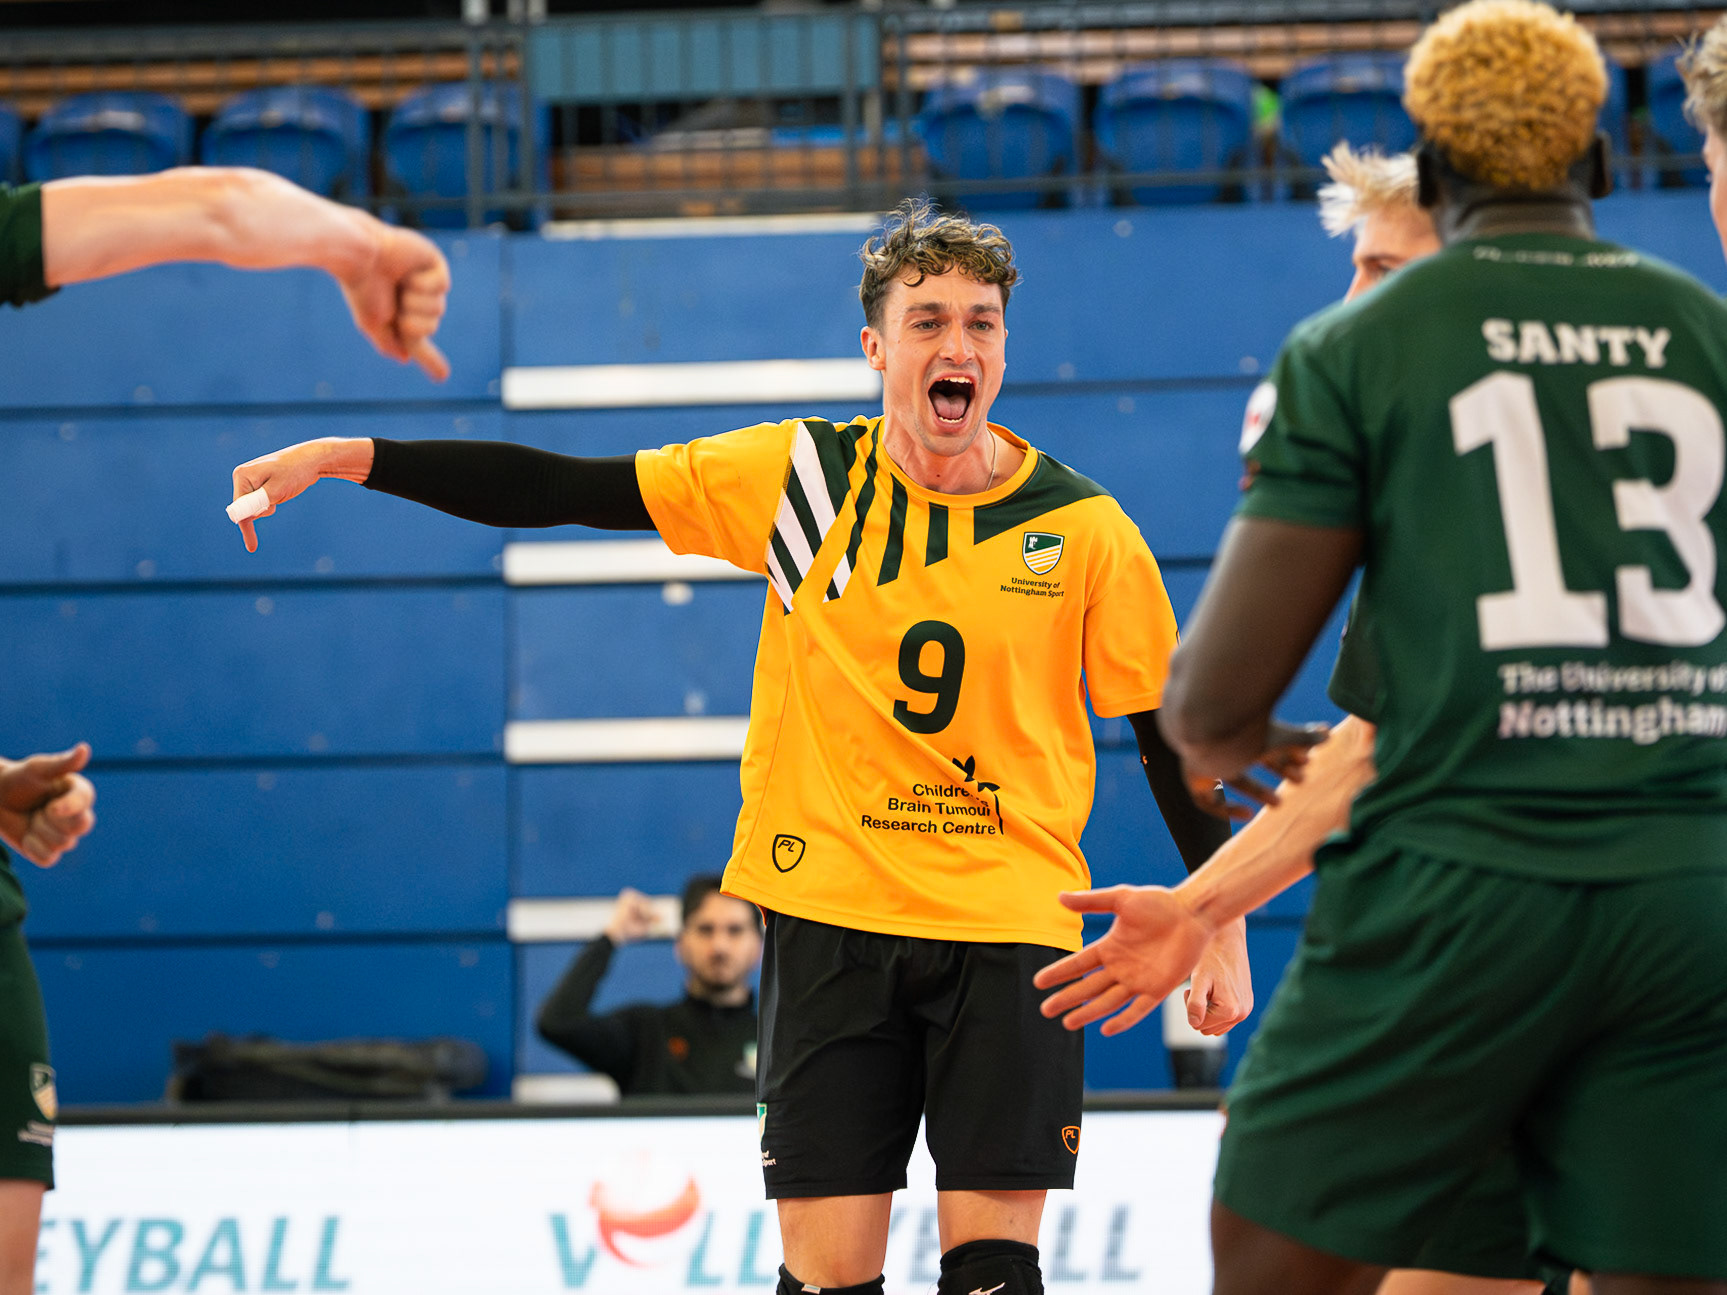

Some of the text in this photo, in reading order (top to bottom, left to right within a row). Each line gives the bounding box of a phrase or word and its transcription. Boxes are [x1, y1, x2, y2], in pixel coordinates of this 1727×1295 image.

[1481, 317, 1671, 368] SANTY
[1448, 370, 1726, 651] 13
[1000, 584, 1065, 599] Nottingham Sport
[1011, 577, 1061, 590] University of
[893, 620, 966, 734] 9
[1498, 662, 1558, 694] The
[1561, 659, 1707, 696] University
[1499, 696, 1727, 746] Nottingham
[888, 797, 932, 814] Brain
[861, 815, 996, 835] Research Centre
[777, 839, 795, 853] PL
[1065, 1129, 1076, 1139] PL
